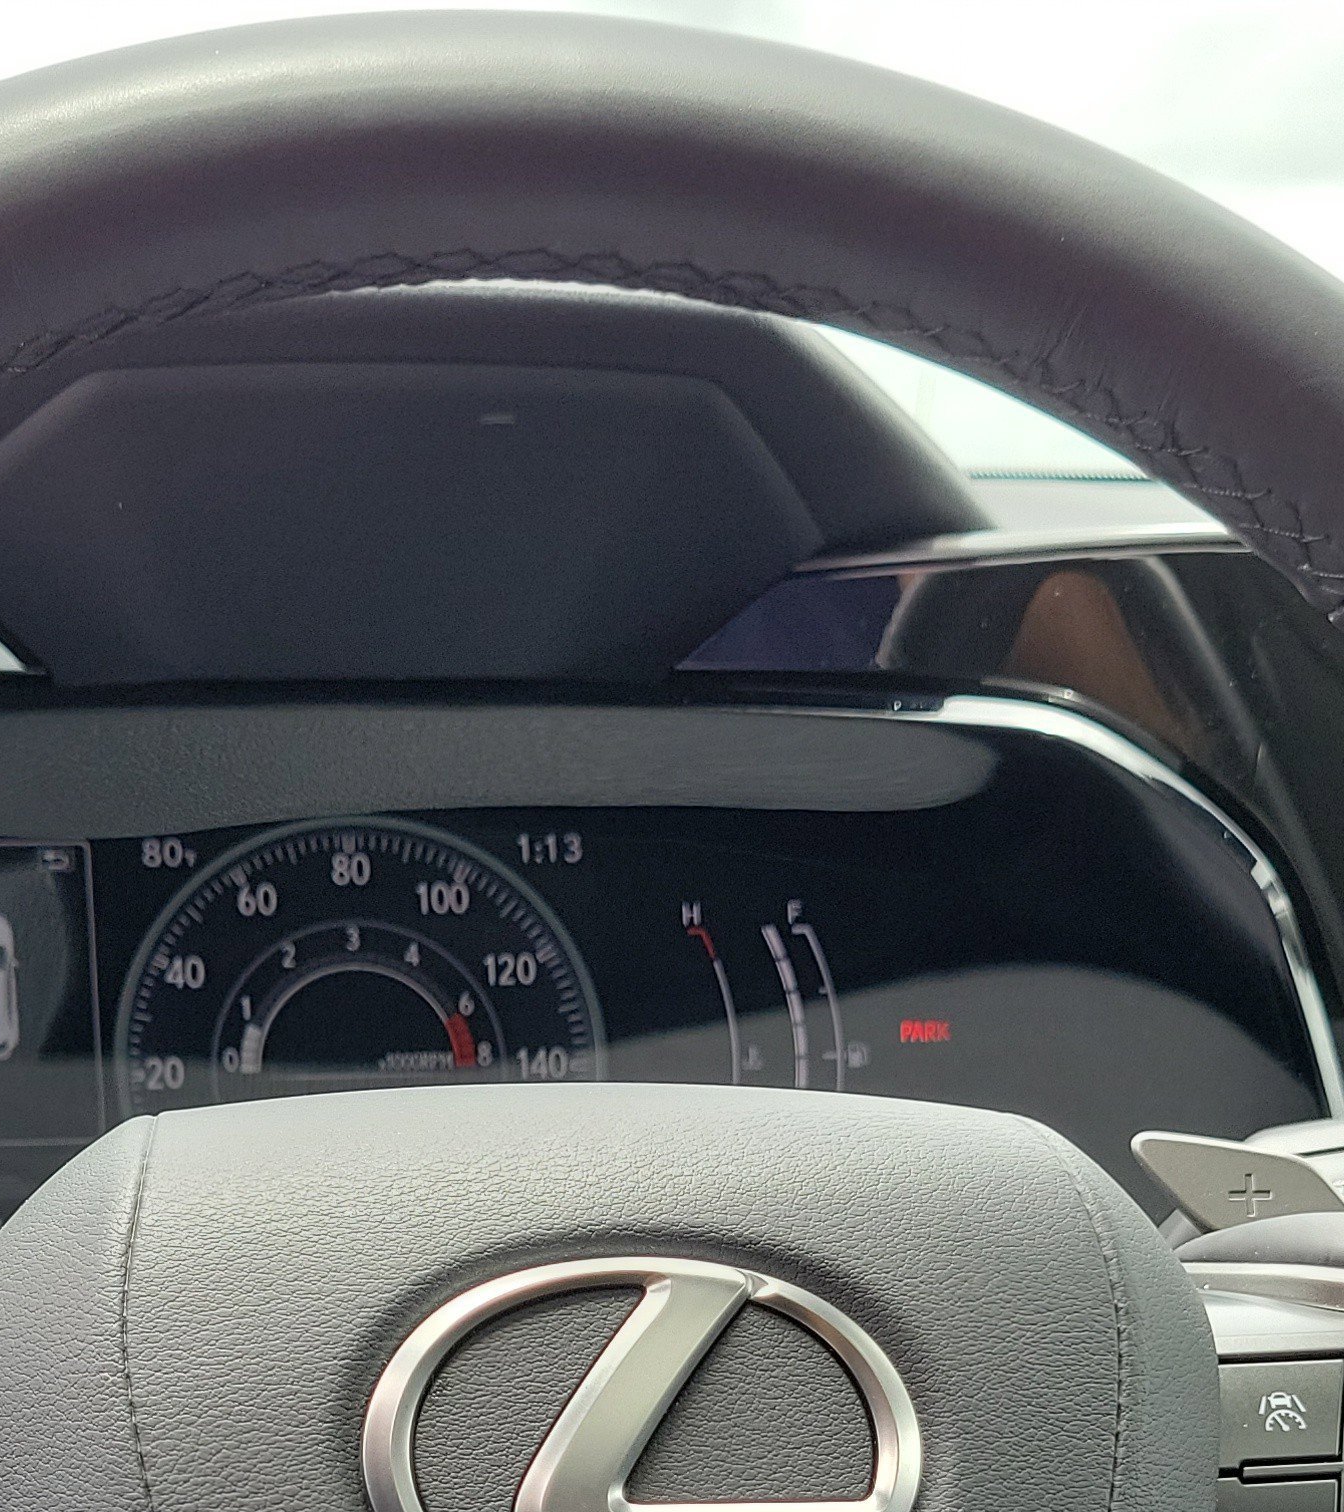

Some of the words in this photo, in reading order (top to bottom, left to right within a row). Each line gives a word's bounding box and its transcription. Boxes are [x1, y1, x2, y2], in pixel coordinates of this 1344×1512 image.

[518, 832, 584, 864] 1:13
[331, 852, 372, 887] 80
[237, 883, 279, 917] 60
[416, 881, 470, 914] 100
[164, 955, 205, 989] 40
[484, 952, 537, 987] 120
[900, 1020, 950, 1043] PARK
[144, 1056, 184, 1090] 20
[516, 1047, 568, 1079] 140
